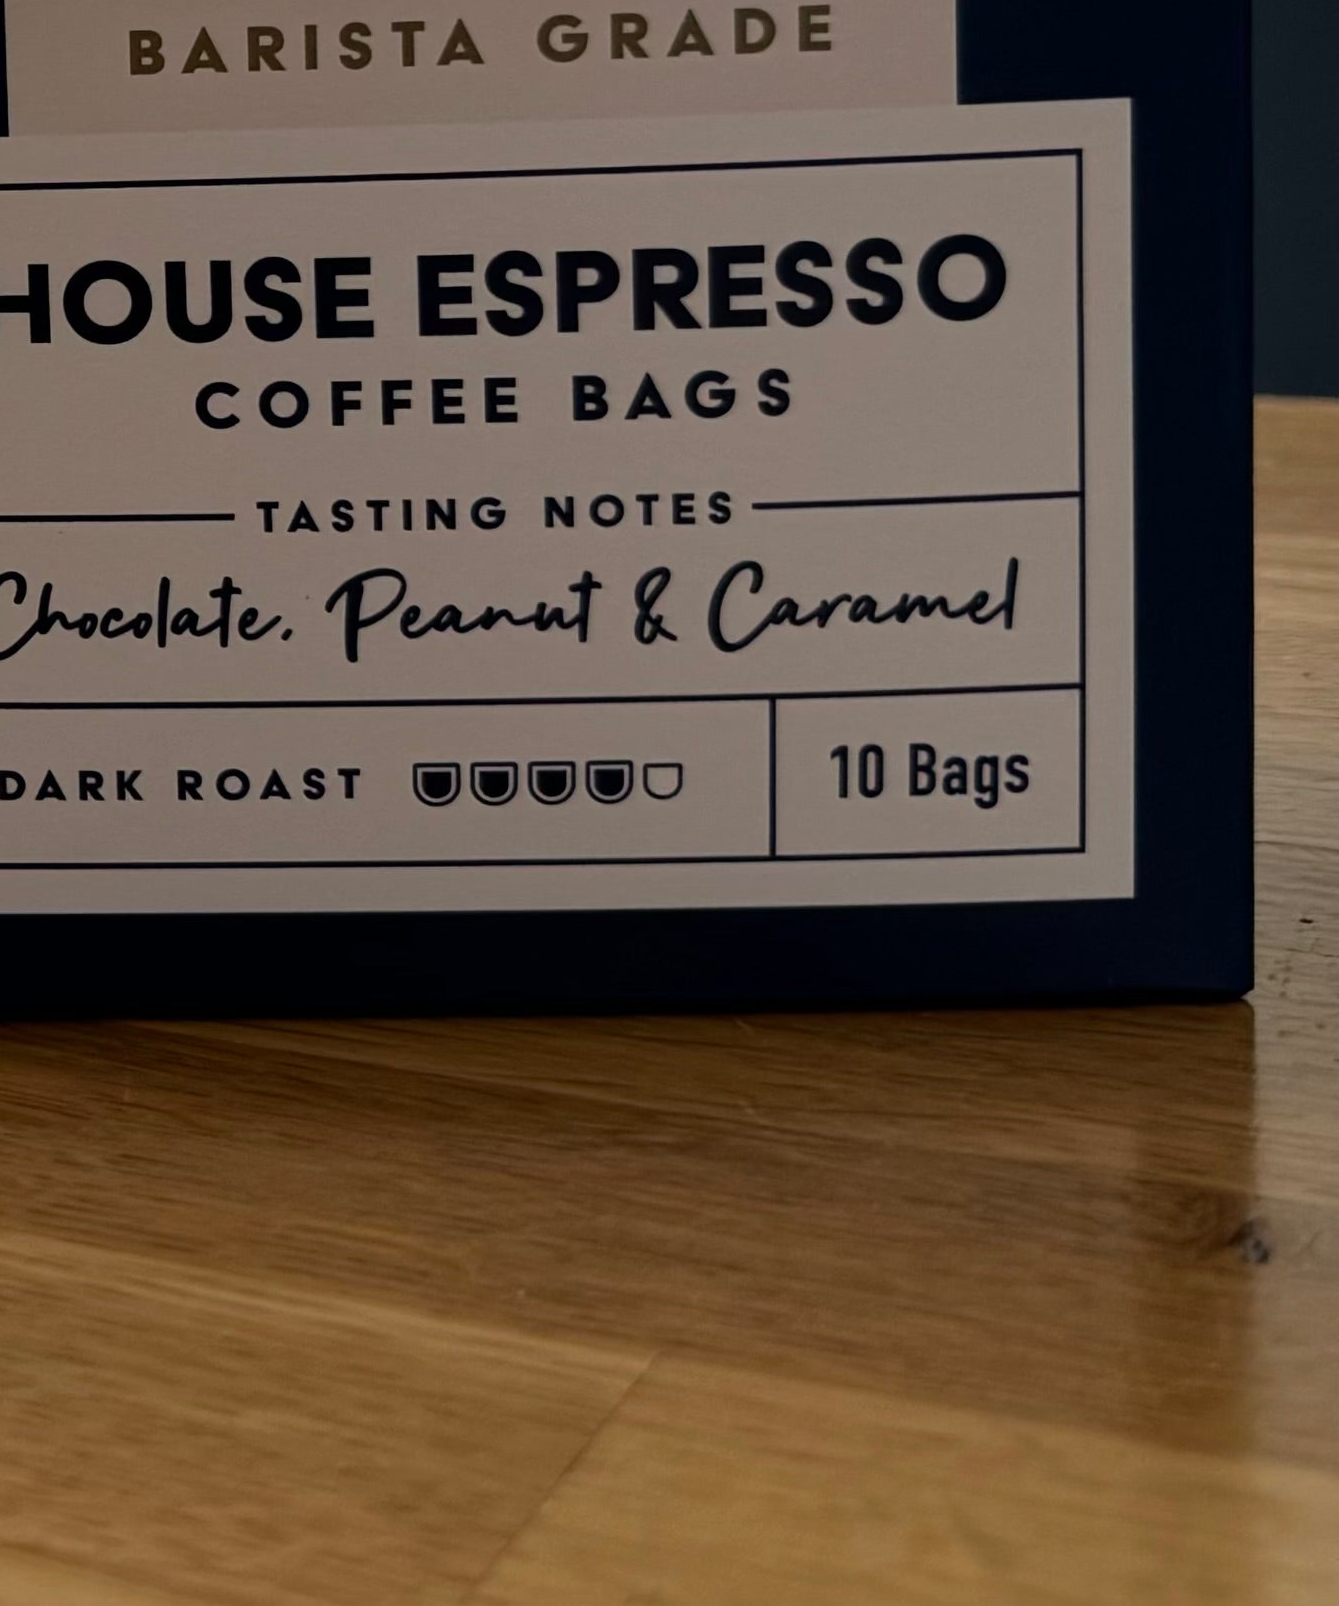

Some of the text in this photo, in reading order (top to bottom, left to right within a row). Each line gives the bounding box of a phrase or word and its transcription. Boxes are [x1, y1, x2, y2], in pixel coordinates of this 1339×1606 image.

[128, 4, 832, 76] BARISTA GRADE
[416, 233, 1007, 337] ESPRESSO
[195, 368, 791, 430] COFFEE BAGS
[256, 491, 732, 533] TASTING NOTES
[324, 567, 603, 664] Peanut
[634, 564, 678, 645] &
[707, 556, 1019, 653] Caramel
[177, 767, 361, 801] ROAST
[830, 742, 1030, 810] 10 Bags
